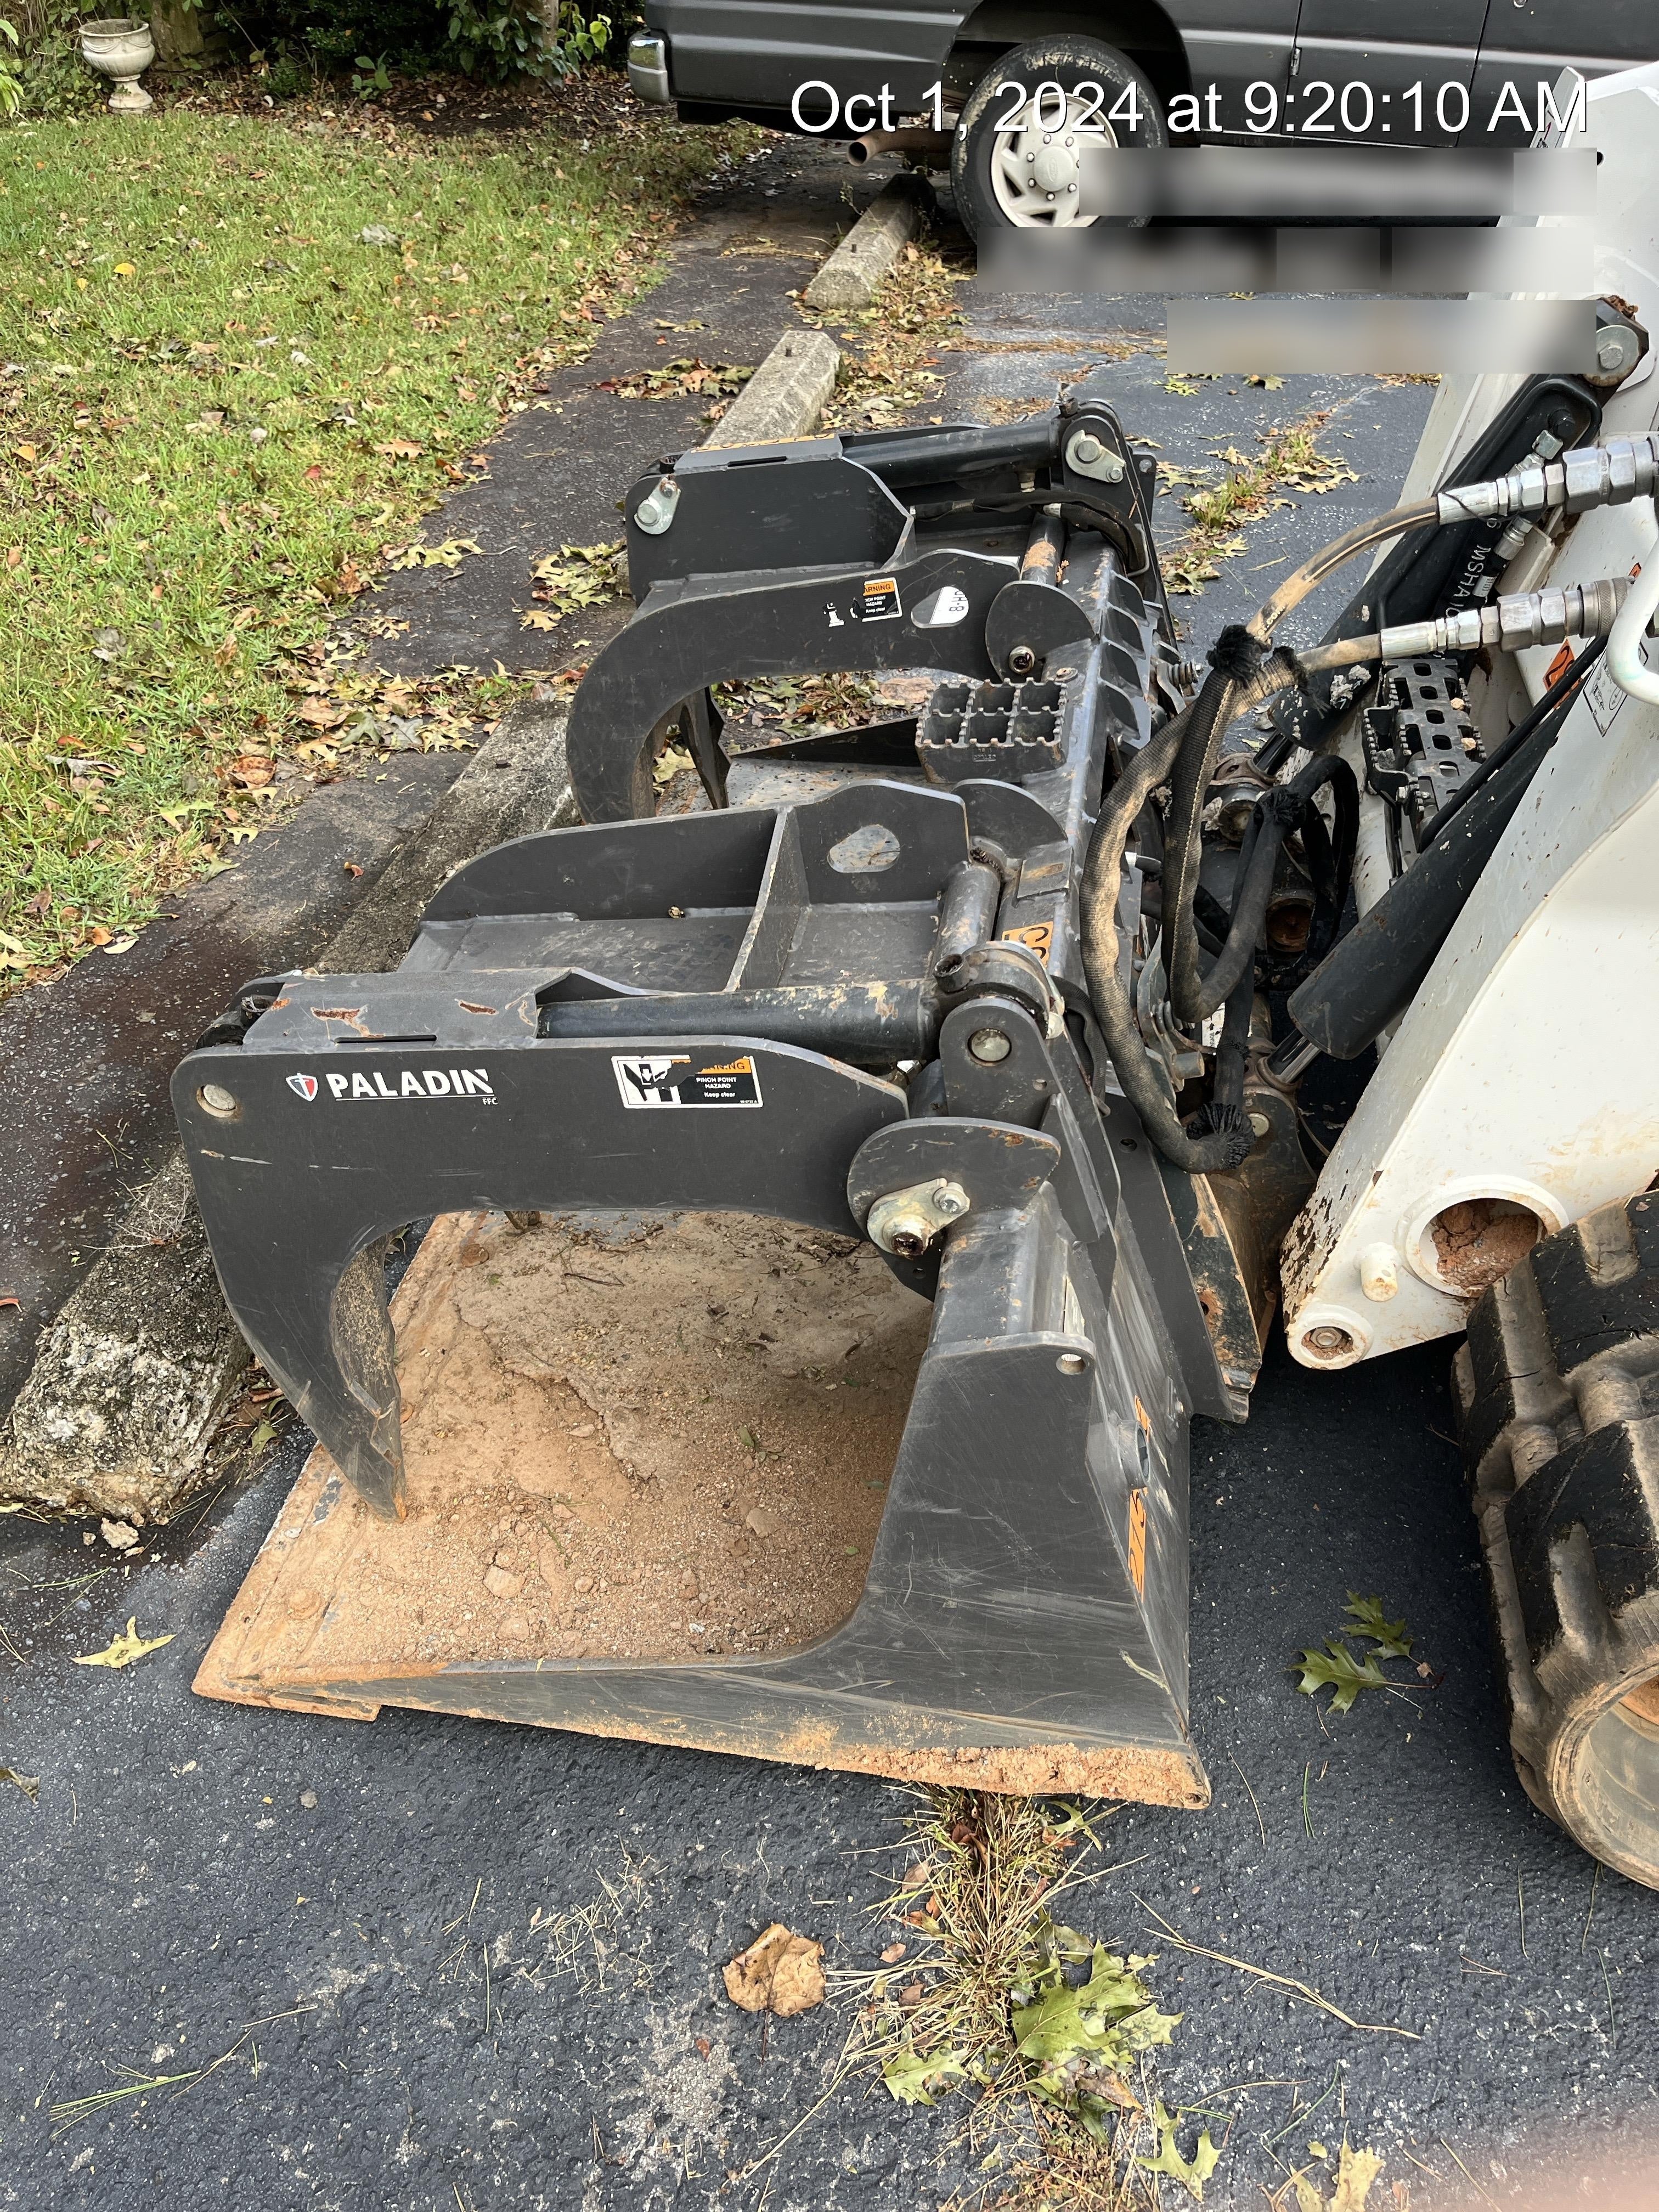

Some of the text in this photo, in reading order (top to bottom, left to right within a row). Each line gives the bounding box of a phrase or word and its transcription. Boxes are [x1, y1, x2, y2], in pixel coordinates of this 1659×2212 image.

[1454, 545, 1491, 597] MSHA
[864, 584, 891, 593] ARNING
[325, 1069, 494, 1098] PALADIN
[482, 1097, 498, 1105] FFC
